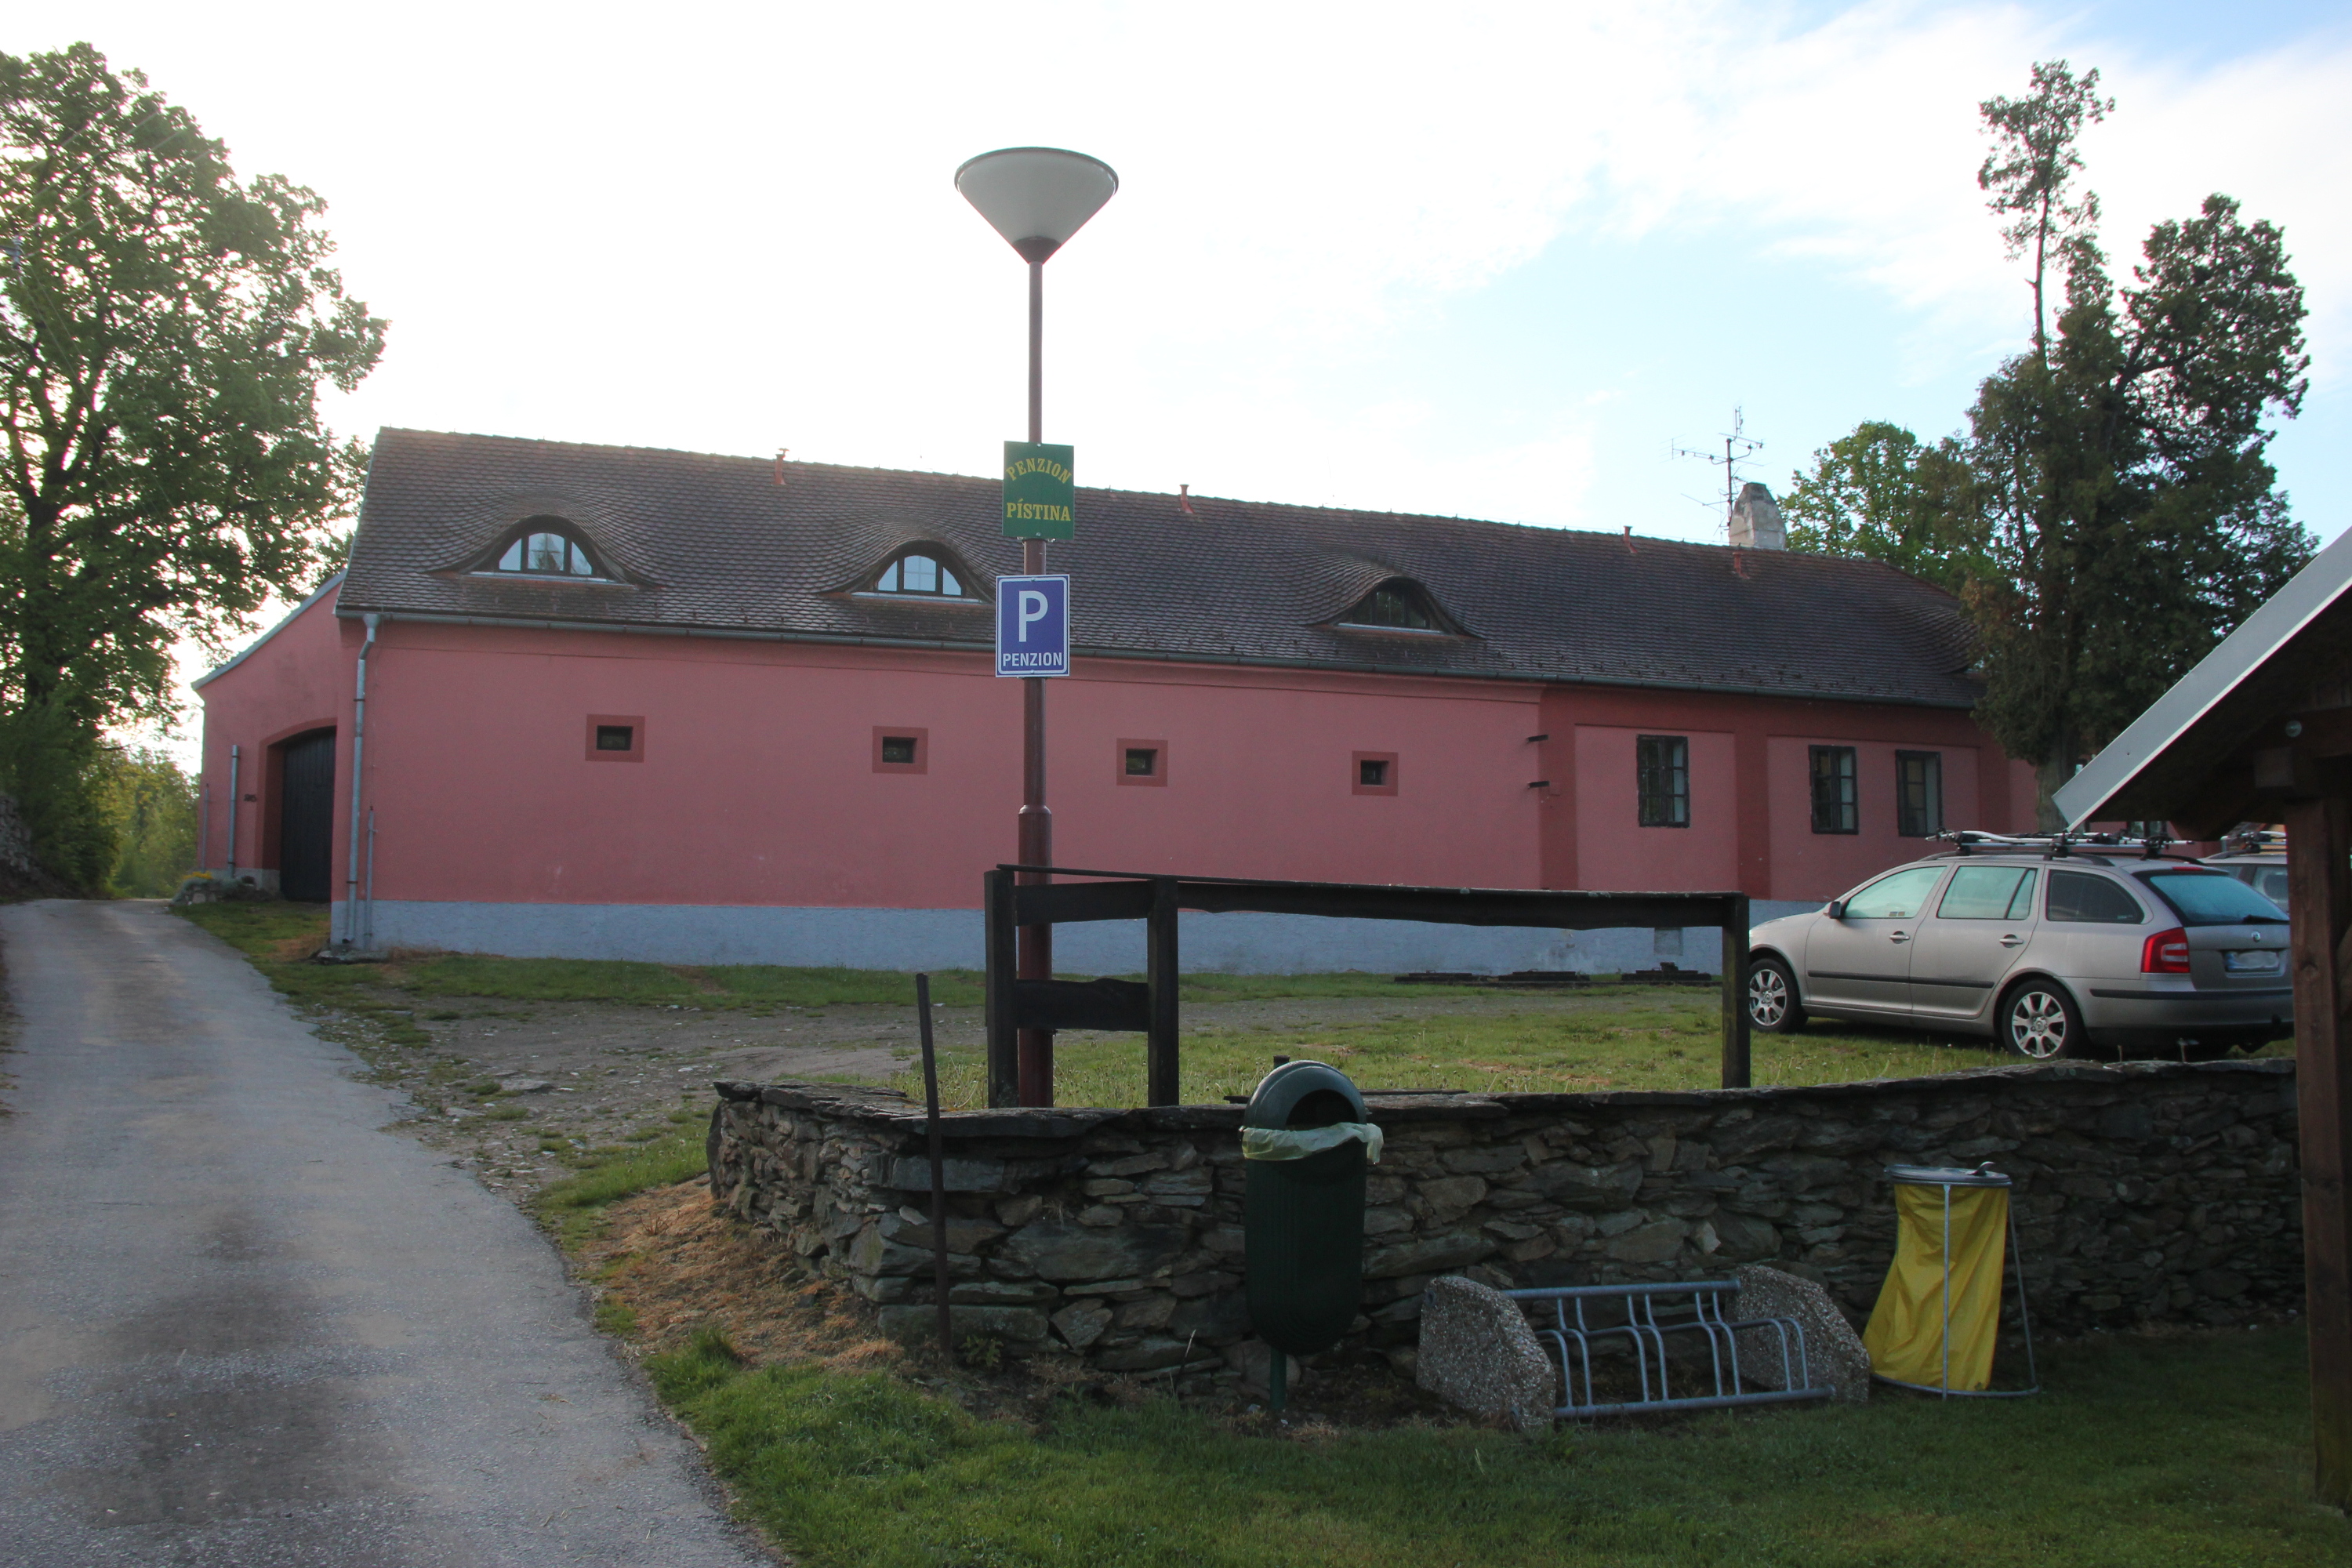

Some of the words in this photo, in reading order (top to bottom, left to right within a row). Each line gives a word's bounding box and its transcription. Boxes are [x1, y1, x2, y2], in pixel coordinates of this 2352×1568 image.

[1006, 458, 1072, 484] PENZION
[1007, 498, 1071, 521] PÍSTINA
[1019, 590, 1048, 642] P
[1003, 652, 1062, 666] PENZION
